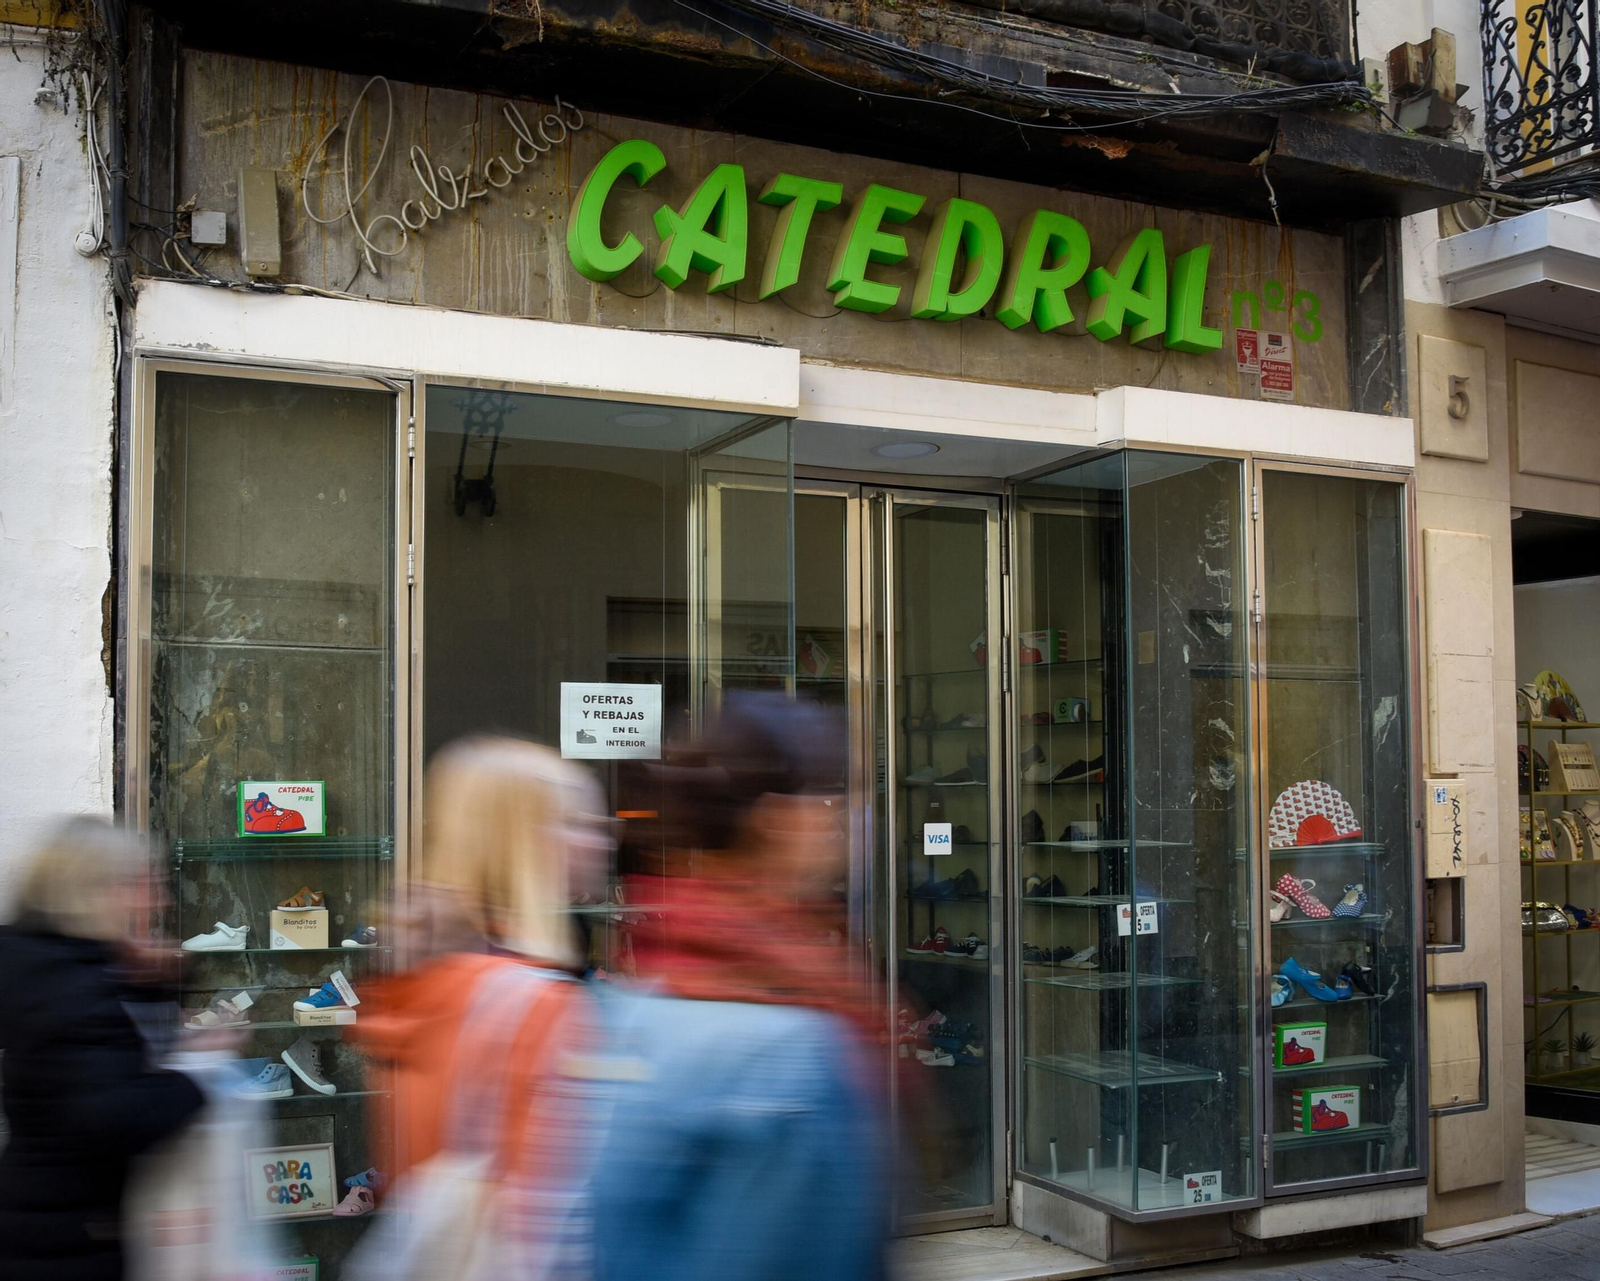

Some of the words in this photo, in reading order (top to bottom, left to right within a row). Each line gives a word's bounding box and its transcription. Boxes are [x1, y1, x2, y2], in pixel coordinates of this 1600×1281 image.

[567, 139, 1223, 354] CATEDRAL
[1262, 361, 1291, 372] Alarma
[1448, 374, 1470, 420] 5
[582, 694, 634, 705] OFERTAS
[582, 710, 590, 719] Y
[593, 710, 645, 720] REBAJAS
[605, 739, 646, 747] INTERIOR
[278, 786, 315, 794] CATEDRAL
[927, 834, 950, 844] VISA
[1140, 905, 1155, 916] OFERTA
[283, 918, 317, 926] Blanditos
[263, 1160, 313, 1184] PARA
[1202, 1175, 1217, 1186] OFERTA
[266, 1183, 314, 1204] CASA
[1194, 1189, 1203, 1203] 25
